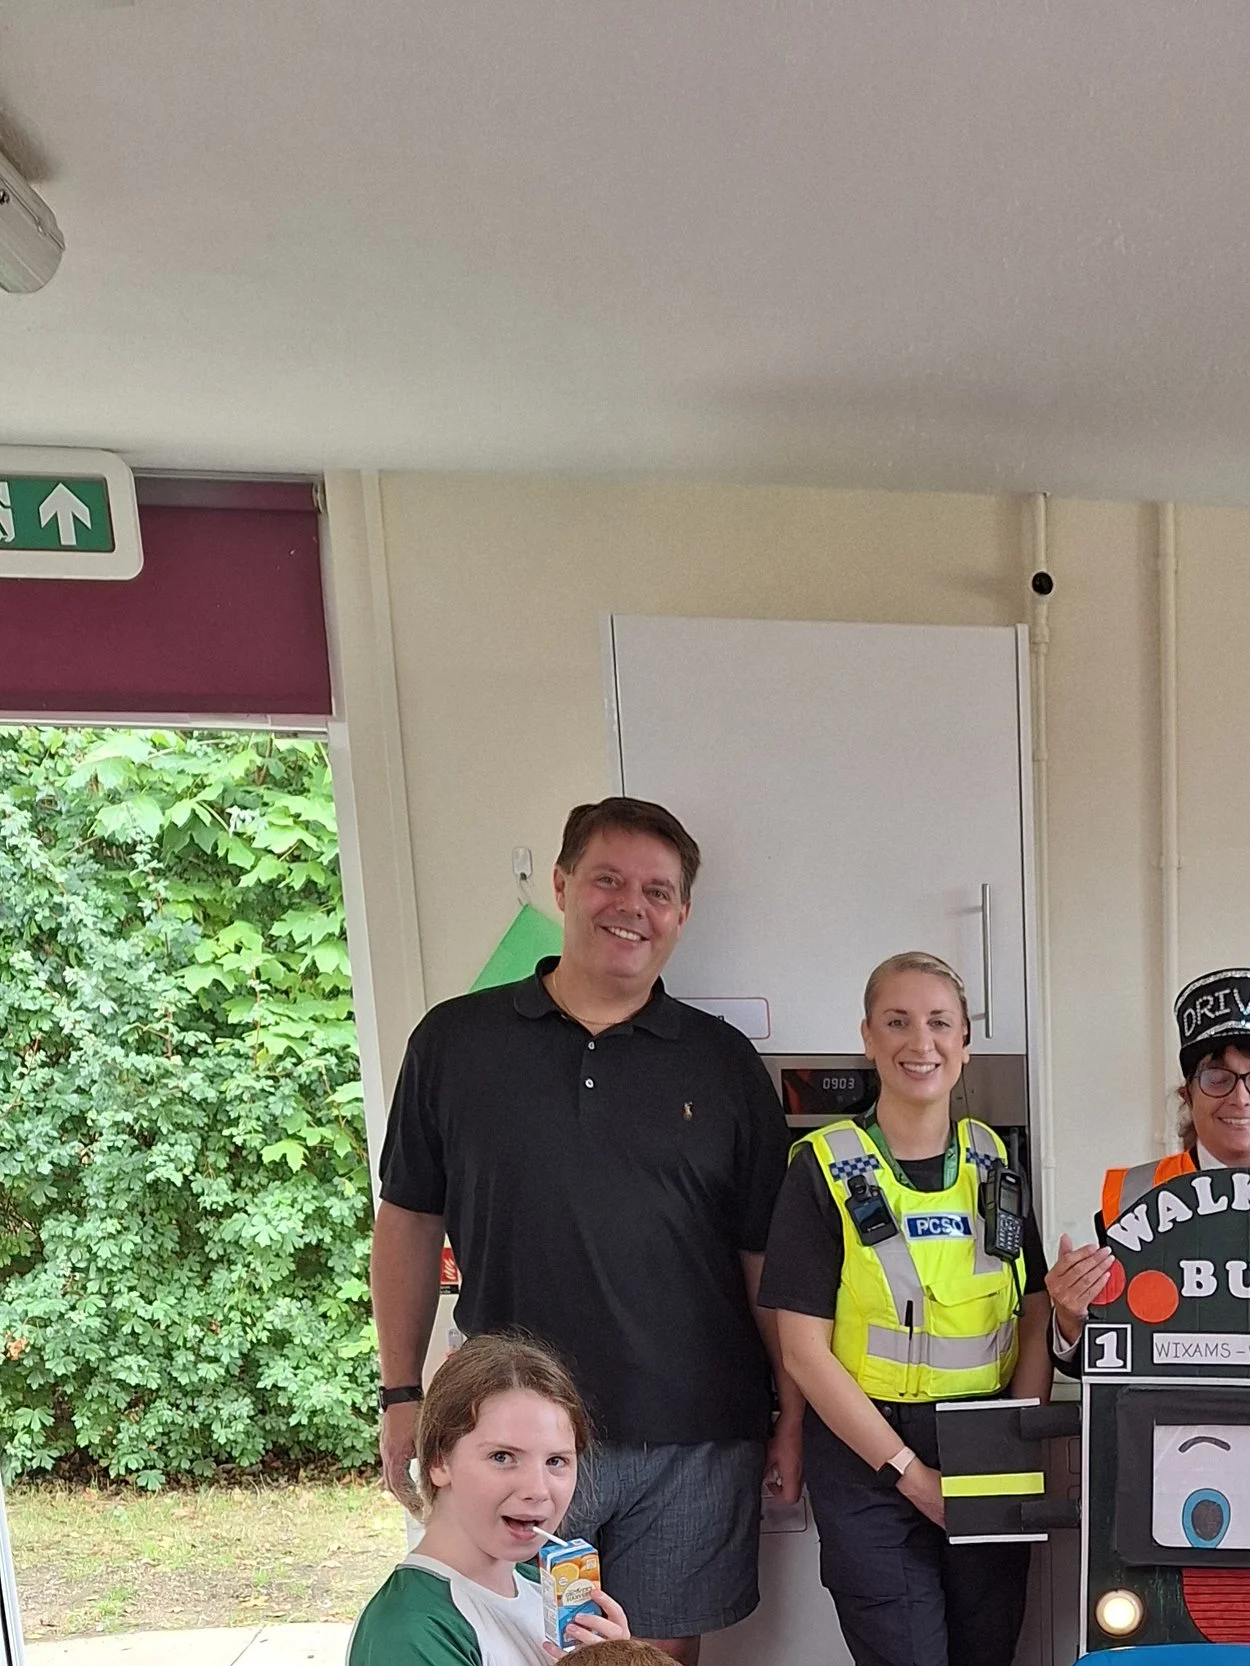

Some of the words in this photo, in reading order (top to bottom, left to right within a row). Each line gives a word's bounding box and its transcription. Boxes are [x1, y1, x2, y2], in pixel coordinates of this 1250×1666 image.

[823, 1077, 855, 1090] 0903
[916, 1217, 964, 1236] PCSO
[1094, 1330, 1125, 1369] 1
